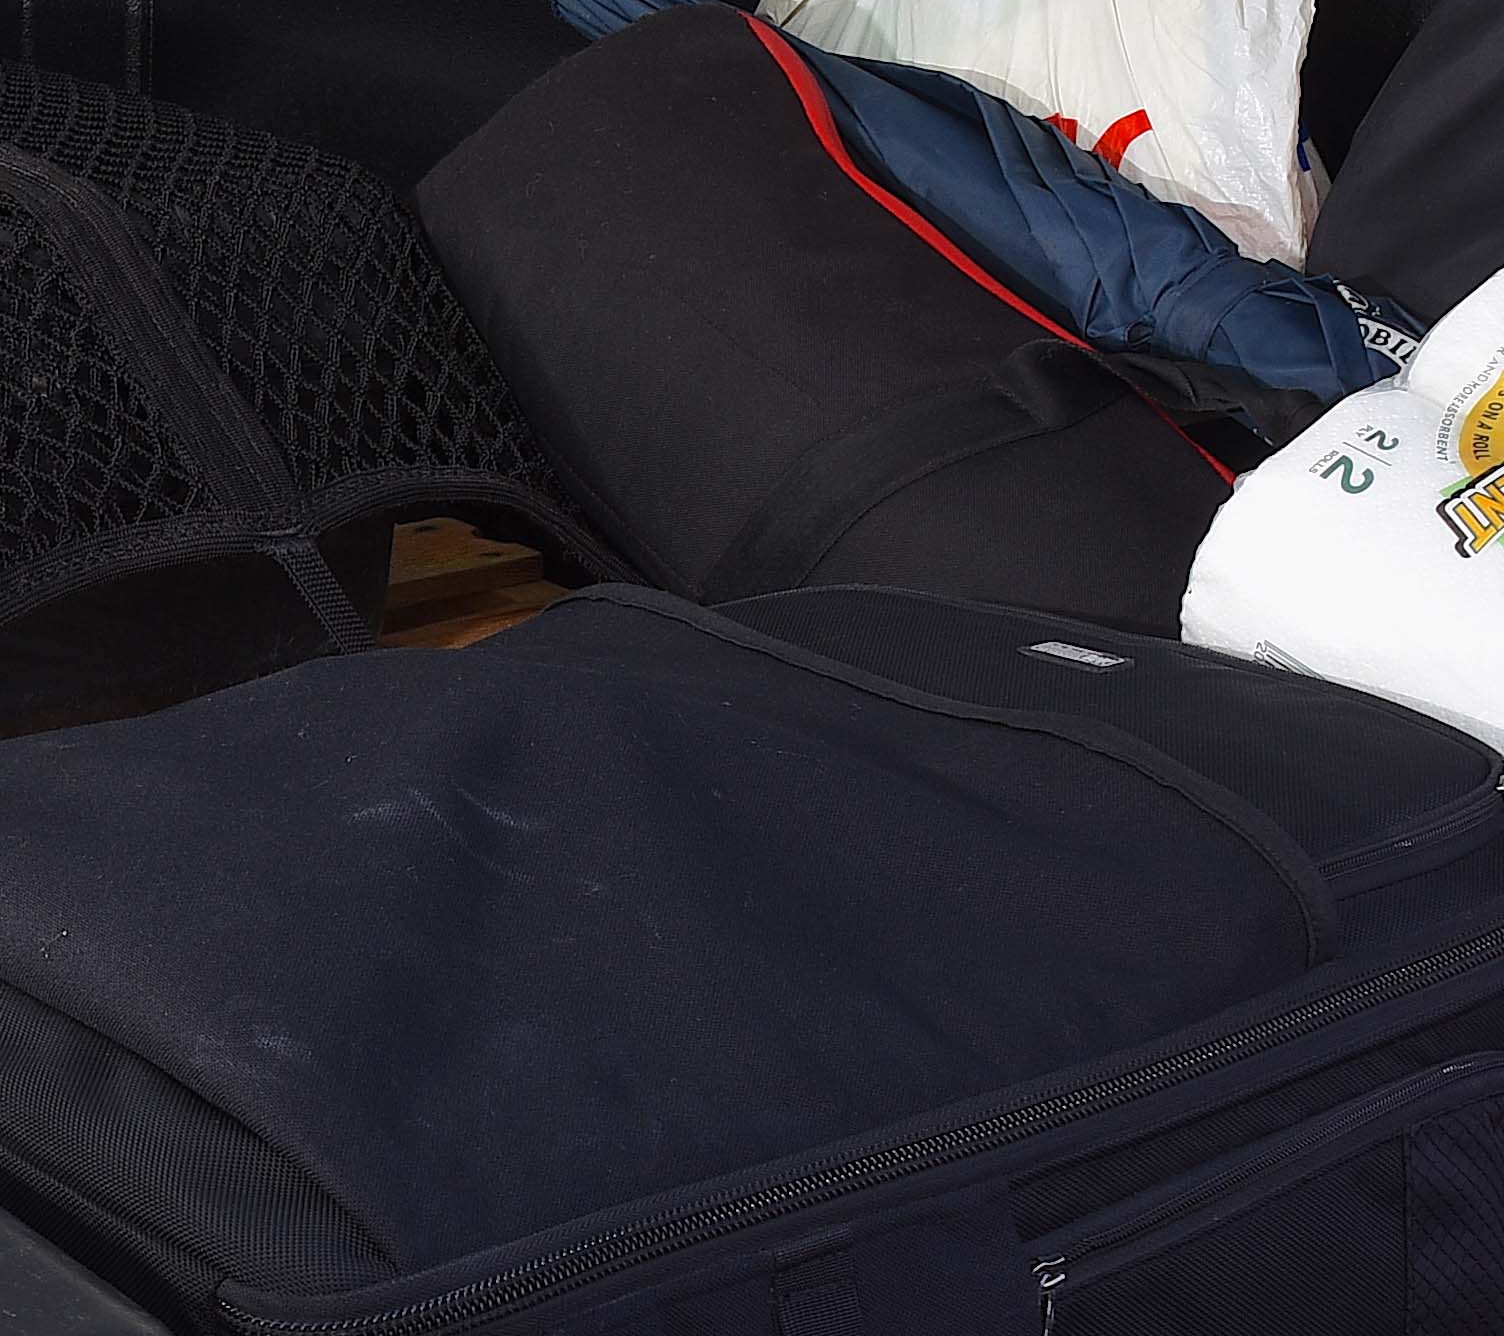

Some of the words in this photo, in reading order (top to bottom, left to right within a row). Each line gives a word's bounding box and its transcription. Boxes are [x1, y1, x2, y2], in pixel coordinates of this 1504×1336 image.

[1476, 358, 1498, 382] AND
[1483, 402, 1504, 421] ON
[1355, 424, 1374, 438] PLY
[1477, 421, 1492, 430] A
[1364, 430, 1399, 451] 2
[1472, 432, 1491, 461] ROLL
[1308, 450, 1340, 474] ROLLS
[1319, 455, 1374, 494] 2
